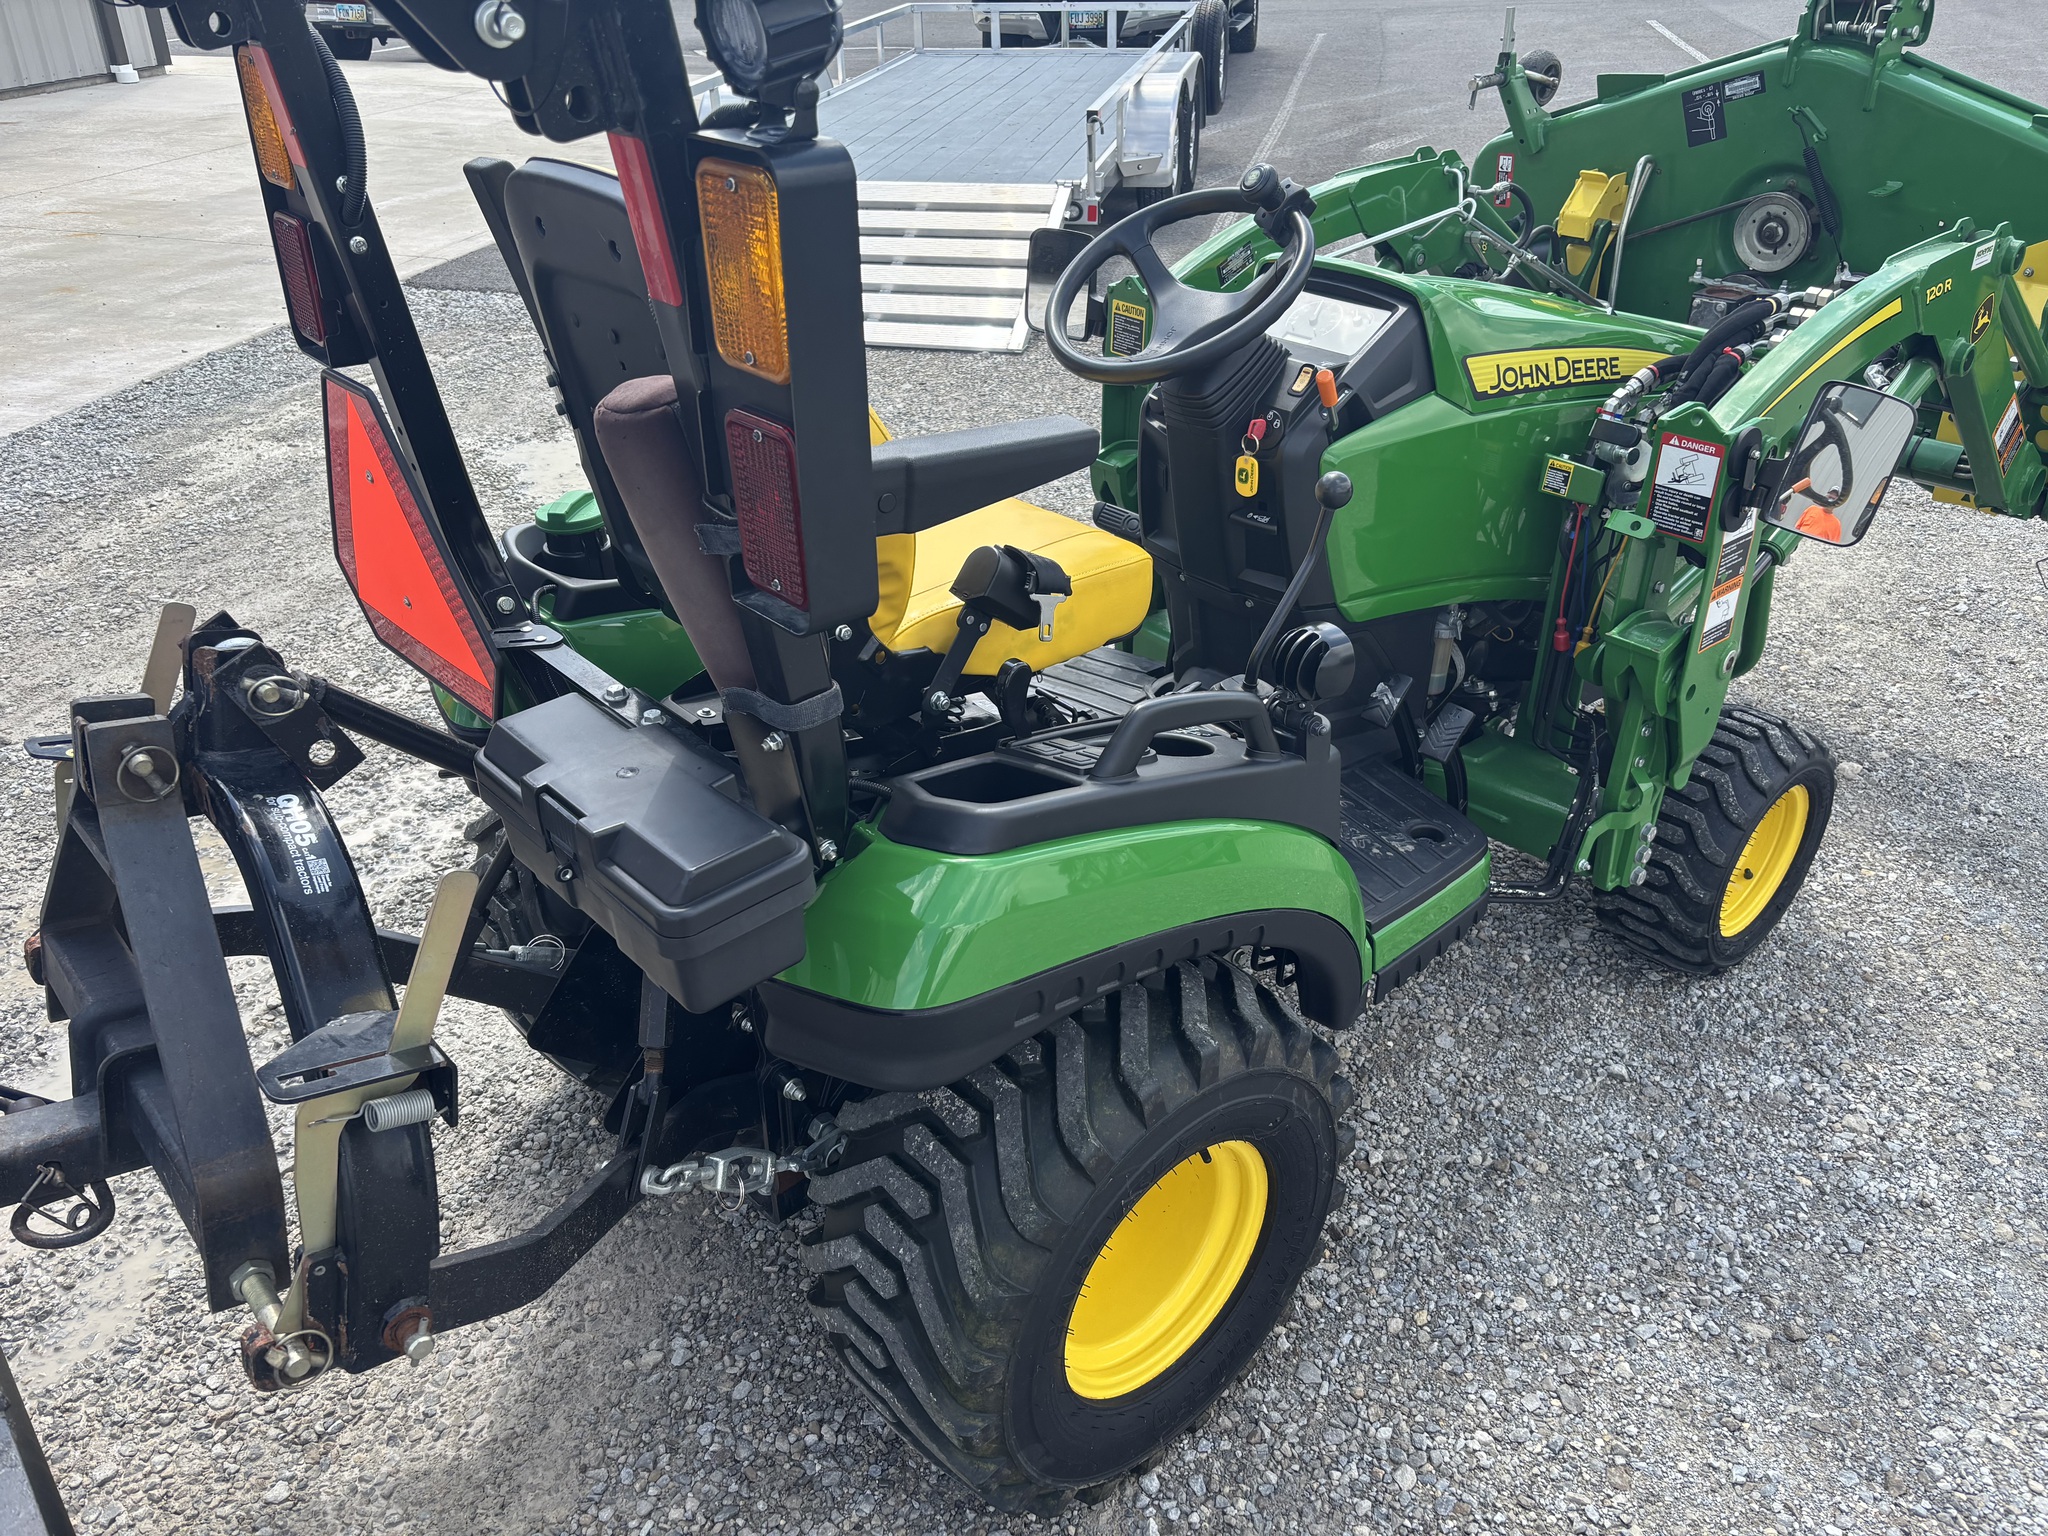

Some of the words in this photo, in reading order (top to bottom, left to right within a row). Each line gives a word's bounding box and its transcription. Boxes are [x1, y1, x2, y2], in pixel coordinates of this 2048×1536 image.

[1070, 12, 1084, 23] FUJ
[1926, 282, 1944, 306] 120
[1944, 278, 1952, 294] R
[1122, 304, 1144, 318] CAUTION
[1489, 363, 1550, 391] JOHN
[1554, 356, 1621, 381] DEERE
[1681, 440, 1716, 454] DANGER
[1716, 580, 1741, 597] WARNING
[276, 794, 318, 846] QH05
[271, 808, 301, 858] sub-compact
[294, 859, 312, 895] tractors
